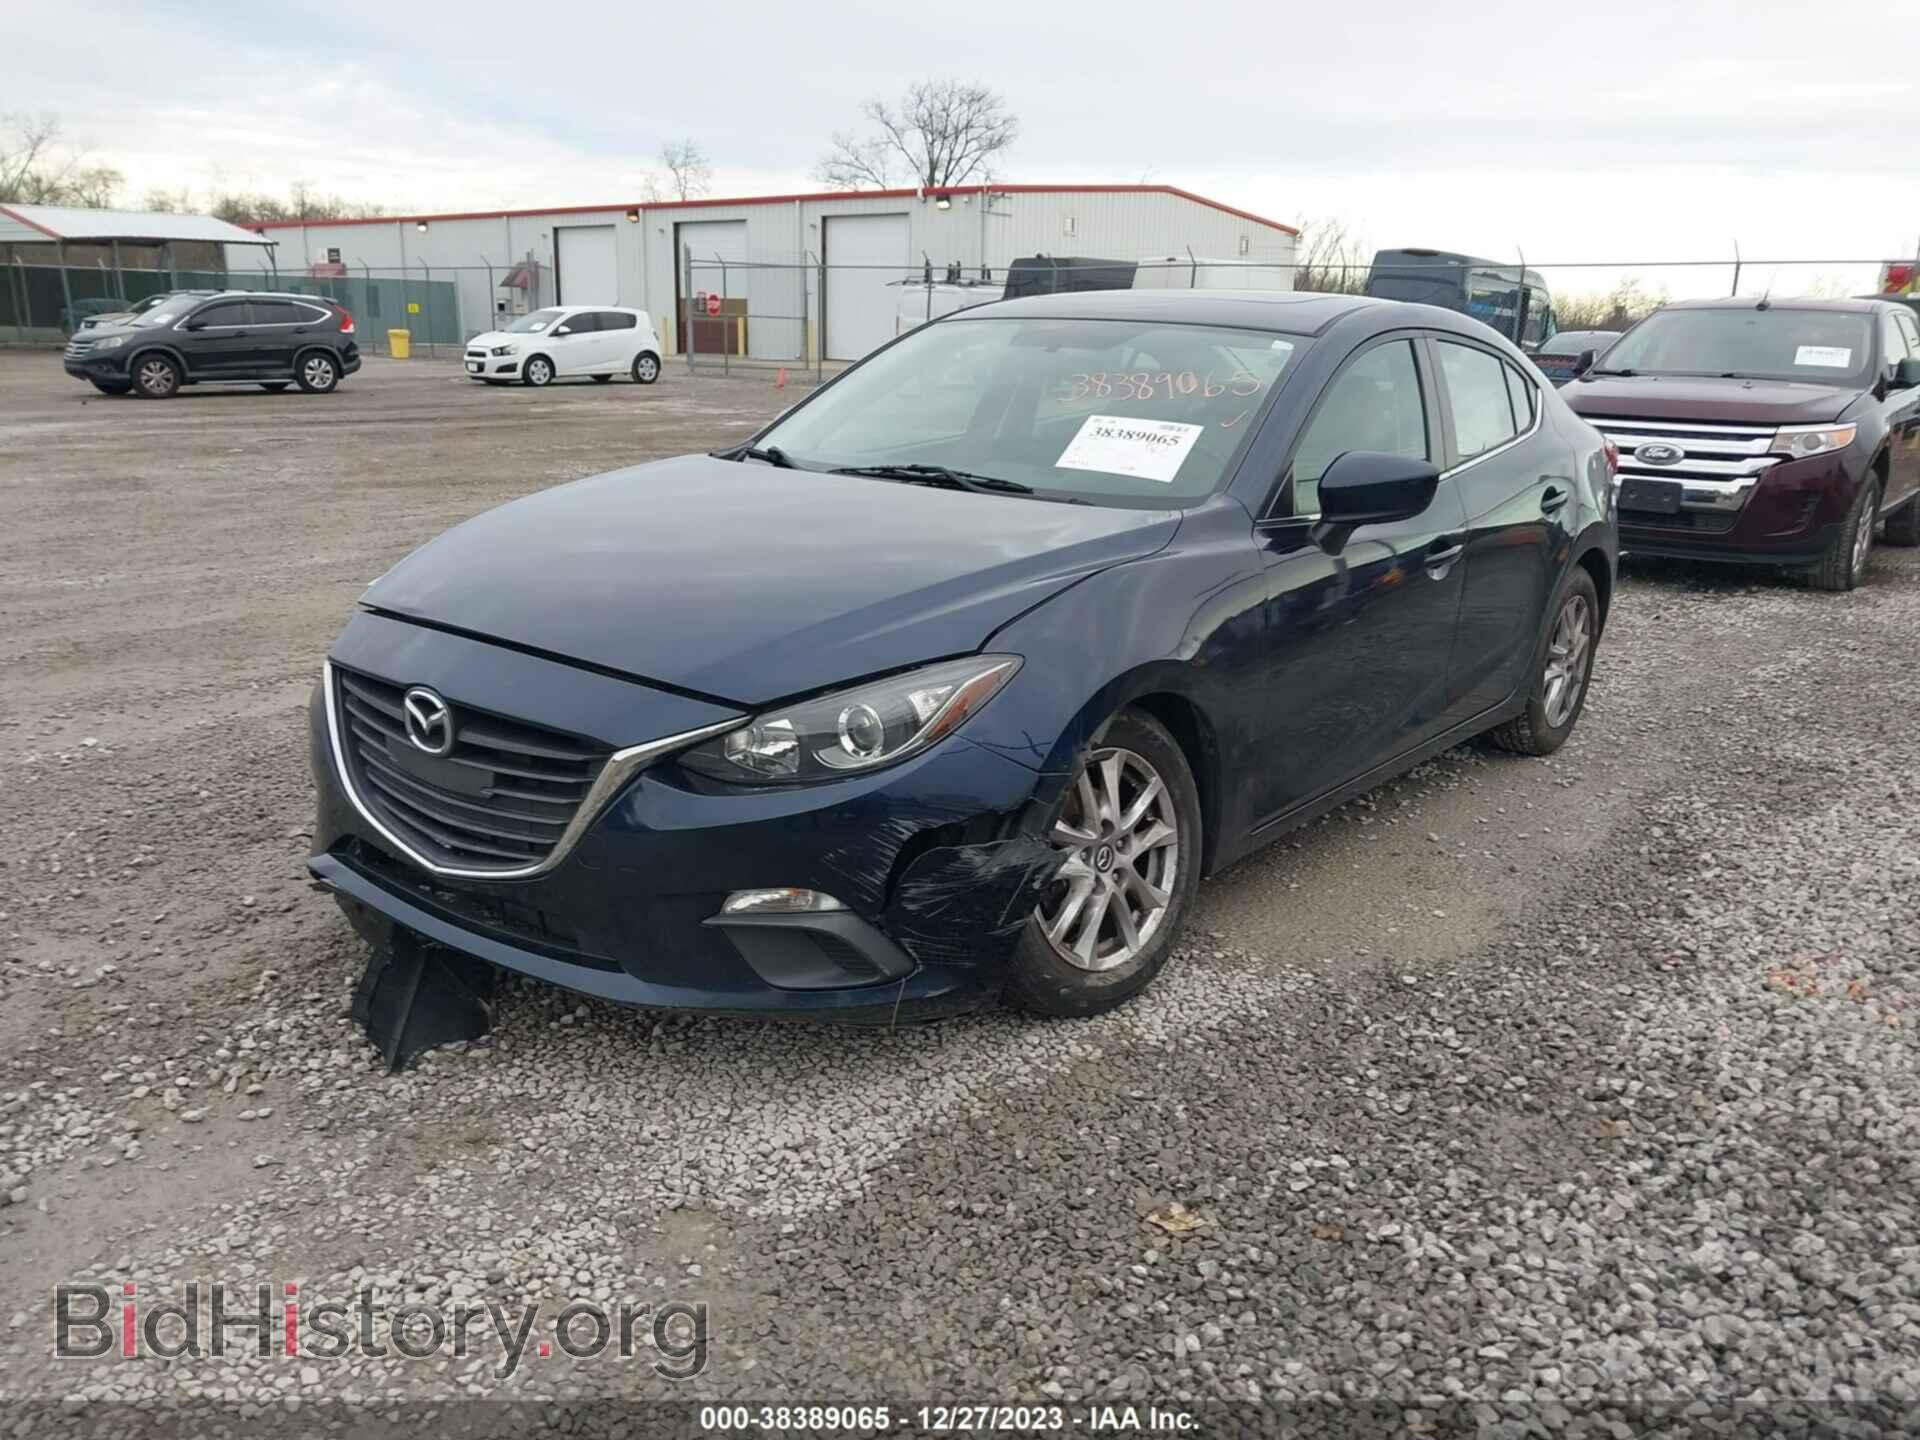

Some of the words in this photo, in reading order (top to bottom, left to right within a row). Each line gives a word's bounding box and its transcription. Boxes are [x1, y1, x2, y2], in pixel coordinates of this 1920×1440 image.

[1057, 370, 1263, 401] 38389065
[1089, 427, 1182, 446] 38389065
[1645, 447, 1671, 458] Ford
